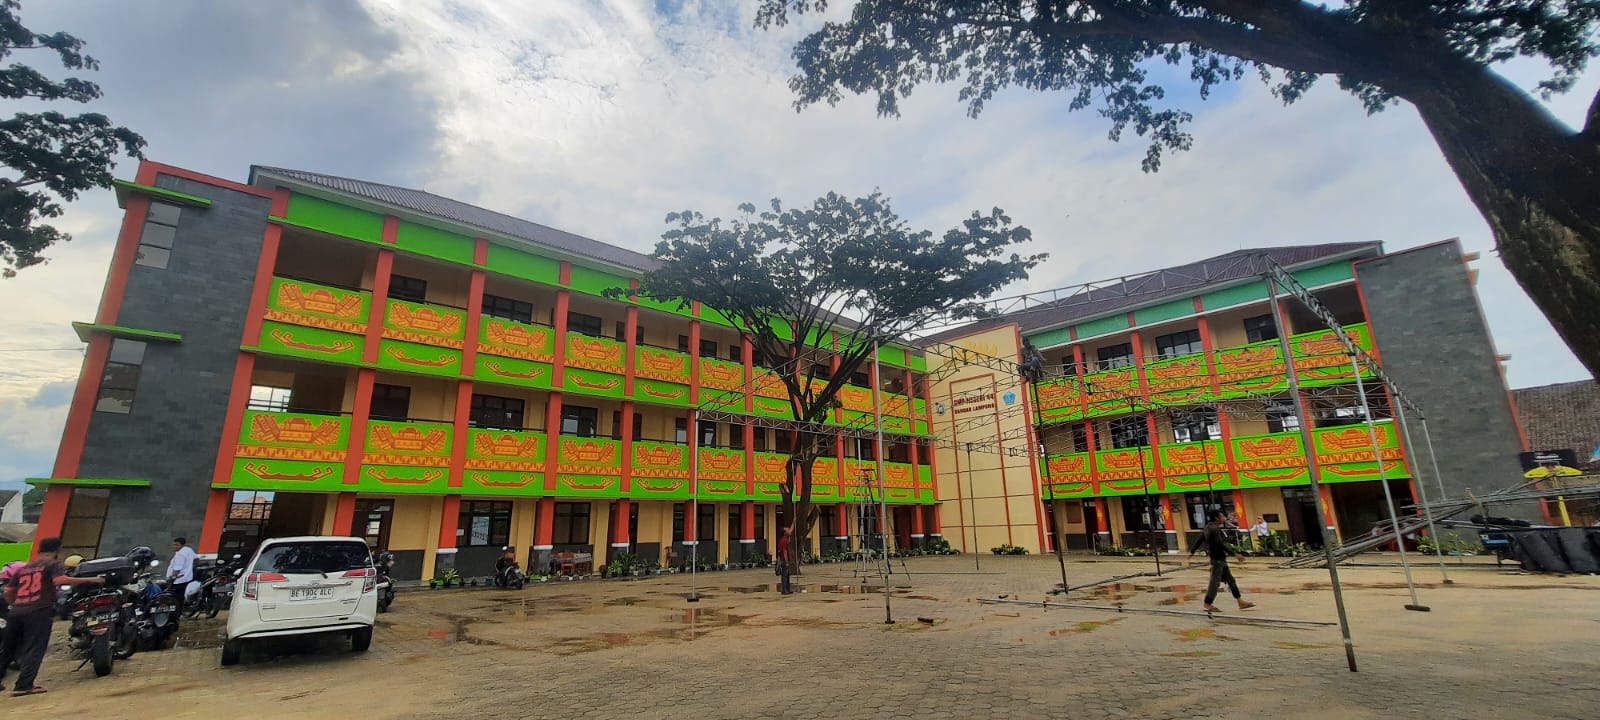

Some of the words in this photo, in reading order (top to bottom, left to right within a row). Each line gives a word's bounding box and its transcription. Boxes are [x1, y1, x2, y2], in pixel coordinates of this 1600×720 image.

[954, 406, 971, 414] BANDAR
[972, 403, 994, 411] LAMPUNG
[17, 571, 42, 596] 28
